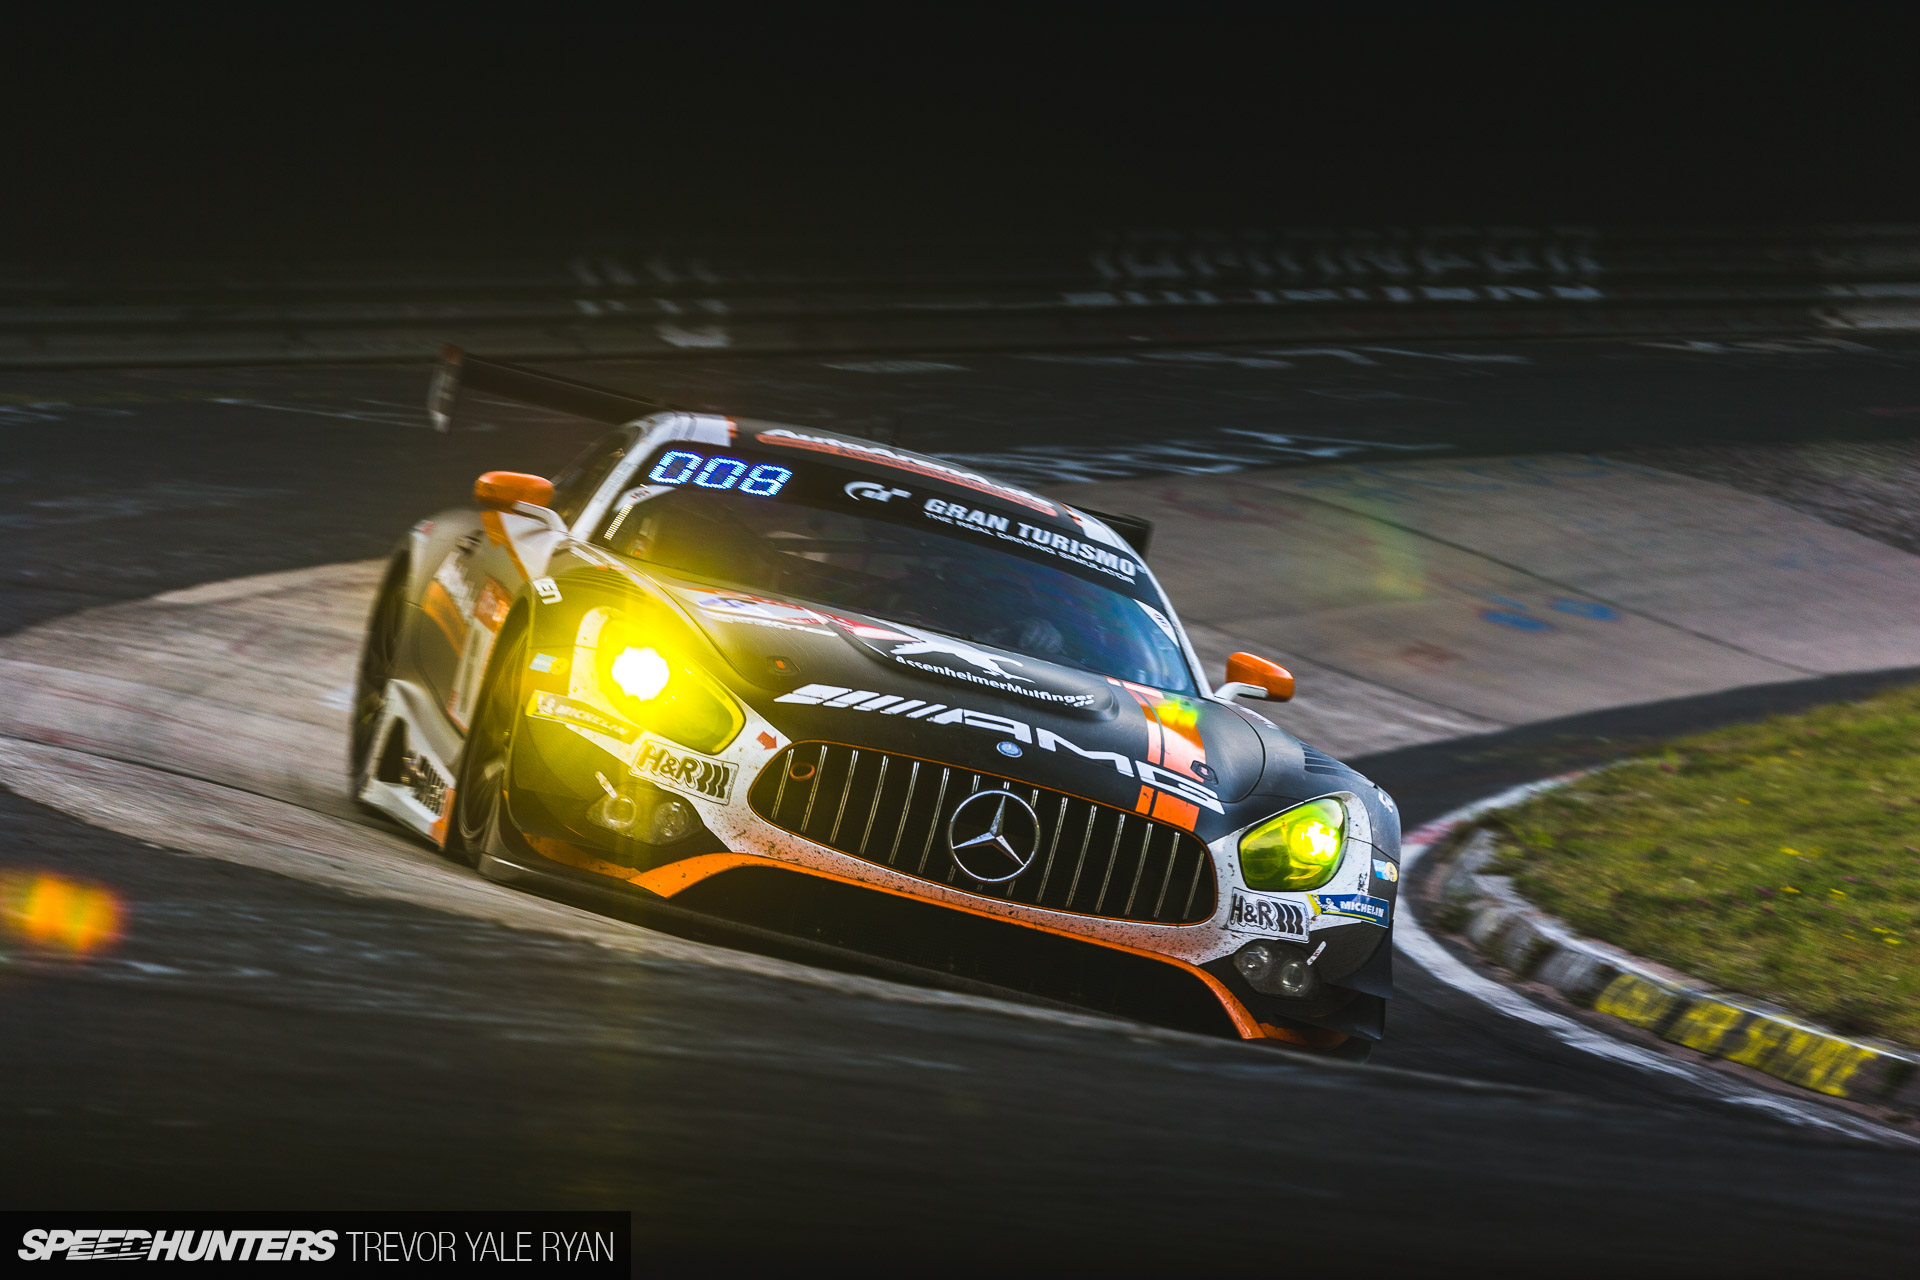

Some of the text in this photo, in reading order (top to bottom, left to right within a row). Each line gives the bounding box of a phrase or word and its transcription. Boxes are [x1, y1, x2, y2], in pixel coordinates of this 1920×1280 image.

[923, 497, 1010, 532] GRAN
[923, 510, 1137, 585] THE REAL DRIVING SIMULATOR
[637, 741, 700, 785] H&R
[928, 707, 1225, 814] AMG
[1230, 892, 1276, 928] H&R
[1340, 900, 1385, 918] MICHELIN
